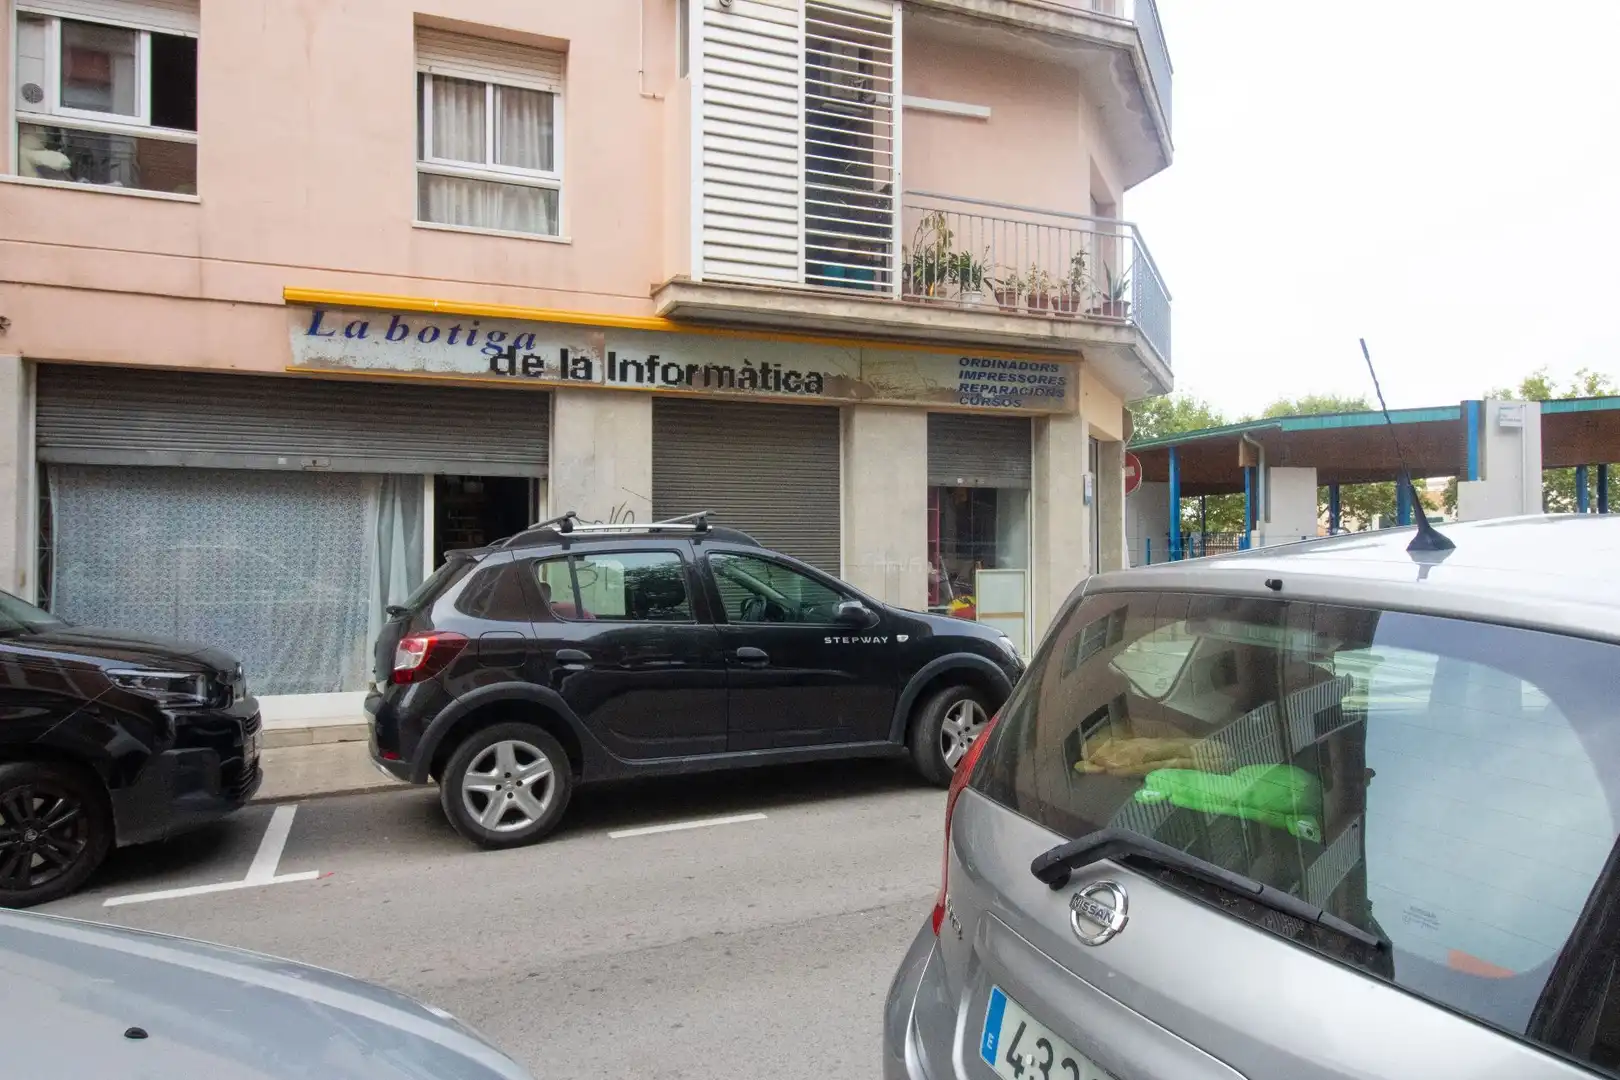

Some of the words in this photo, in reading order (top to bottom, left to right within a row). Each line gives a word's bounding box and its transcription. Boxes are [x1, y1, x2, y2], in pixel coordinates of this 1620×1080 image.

[304, 309, 371, 340] La
[384, 314, 538, 356] botiga
[489, 345, 544, 378] de
[560, 348, 593, 381] la
[607, 351, 825, 395] Informàtica
[958, 357, 1060, 373] ORDINADORS
[958, 370, 1068, 386] IMPRESSORES
[958, 383, 1066, 398] REPARACIONS
[959, 396, 1023, 408] CURSOS
[824, 636, 889, 644] STEPWAY
[1071, 894, 1116, 925] NISSAN
